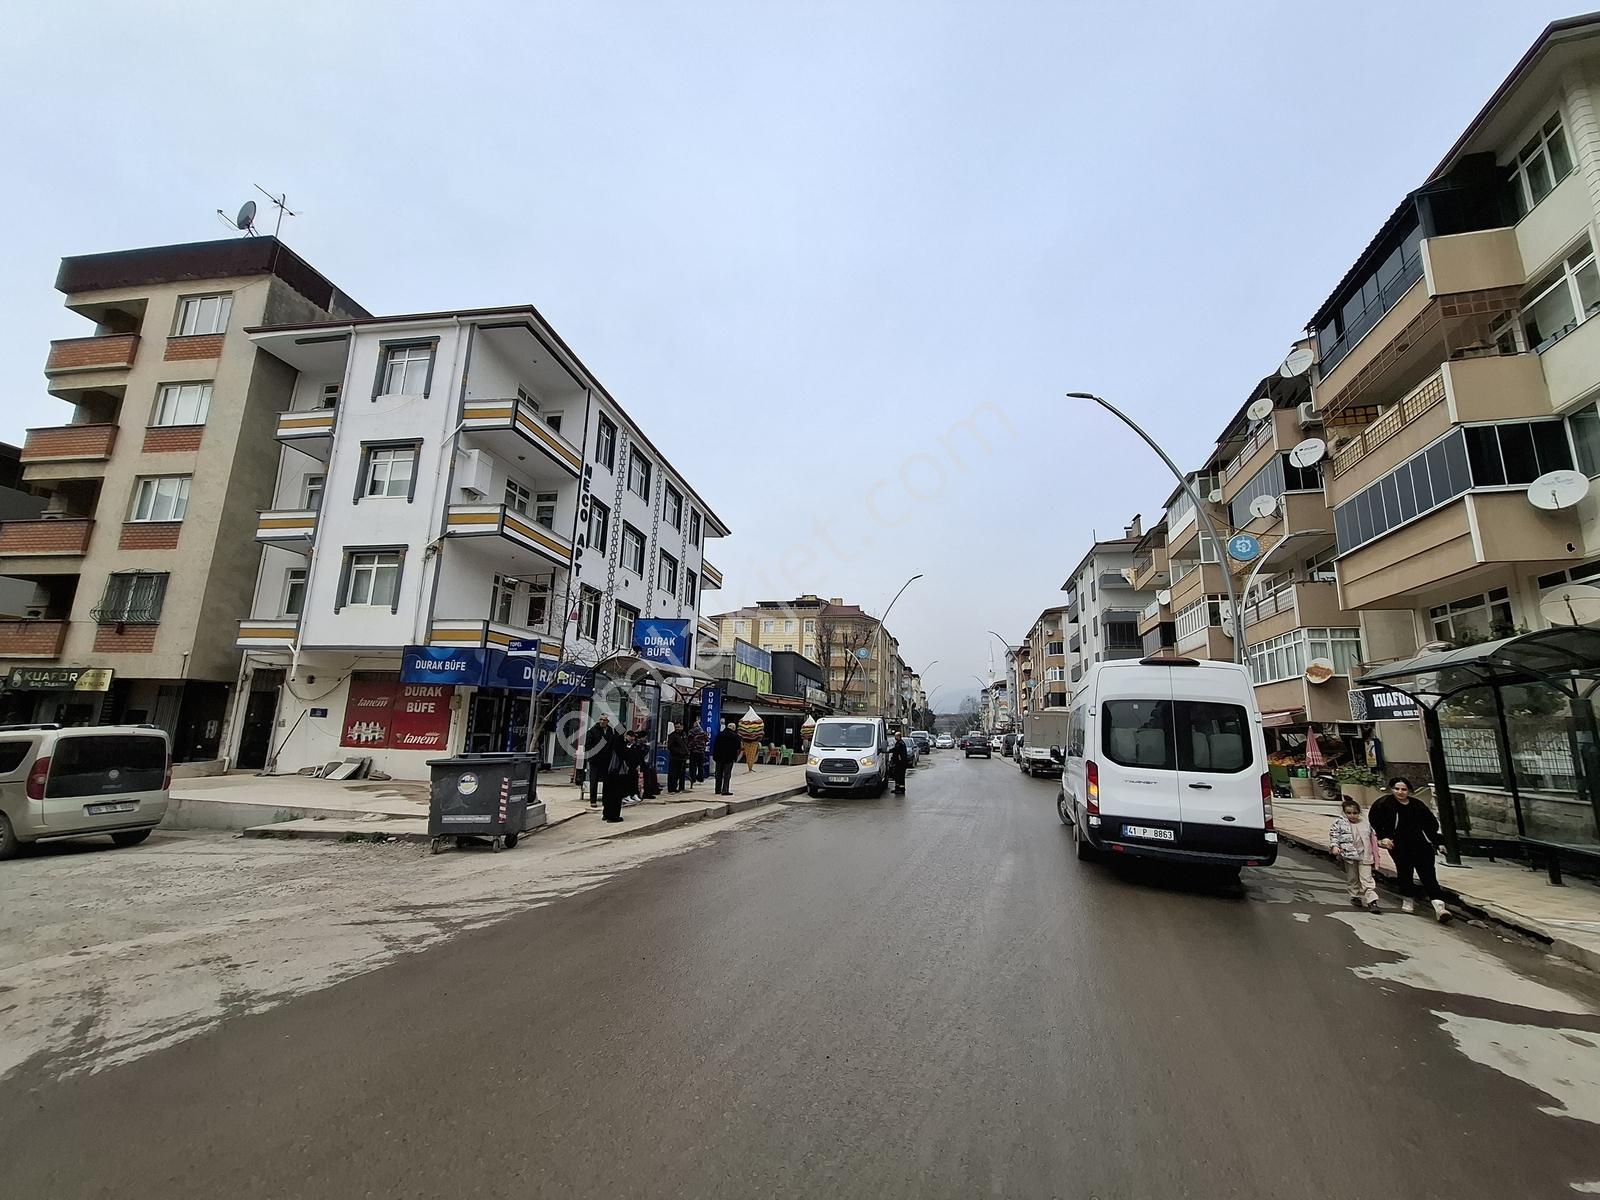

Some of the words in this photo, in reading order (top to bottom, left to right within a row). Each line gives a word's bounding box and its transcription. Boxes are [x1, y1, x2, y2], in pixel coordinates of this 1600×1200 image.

[580, 463, 593, 523] NECO
[574, 533, 585, 577] APT
[644, 636, 676, 646] DURAK
[646, 647, 671, 657] BÜFE
[415, 660, 443, 670] DURAK
[444, 659, 466, 671] BÜFE
[404, 686, 443, 697] DURAK
[406, 699, 436, 713] BÜFE
[1128, 826, 1137, 835] 41
[1142, 828, 1148, 836] P
[1153, 830, 1173, 839] 8863
